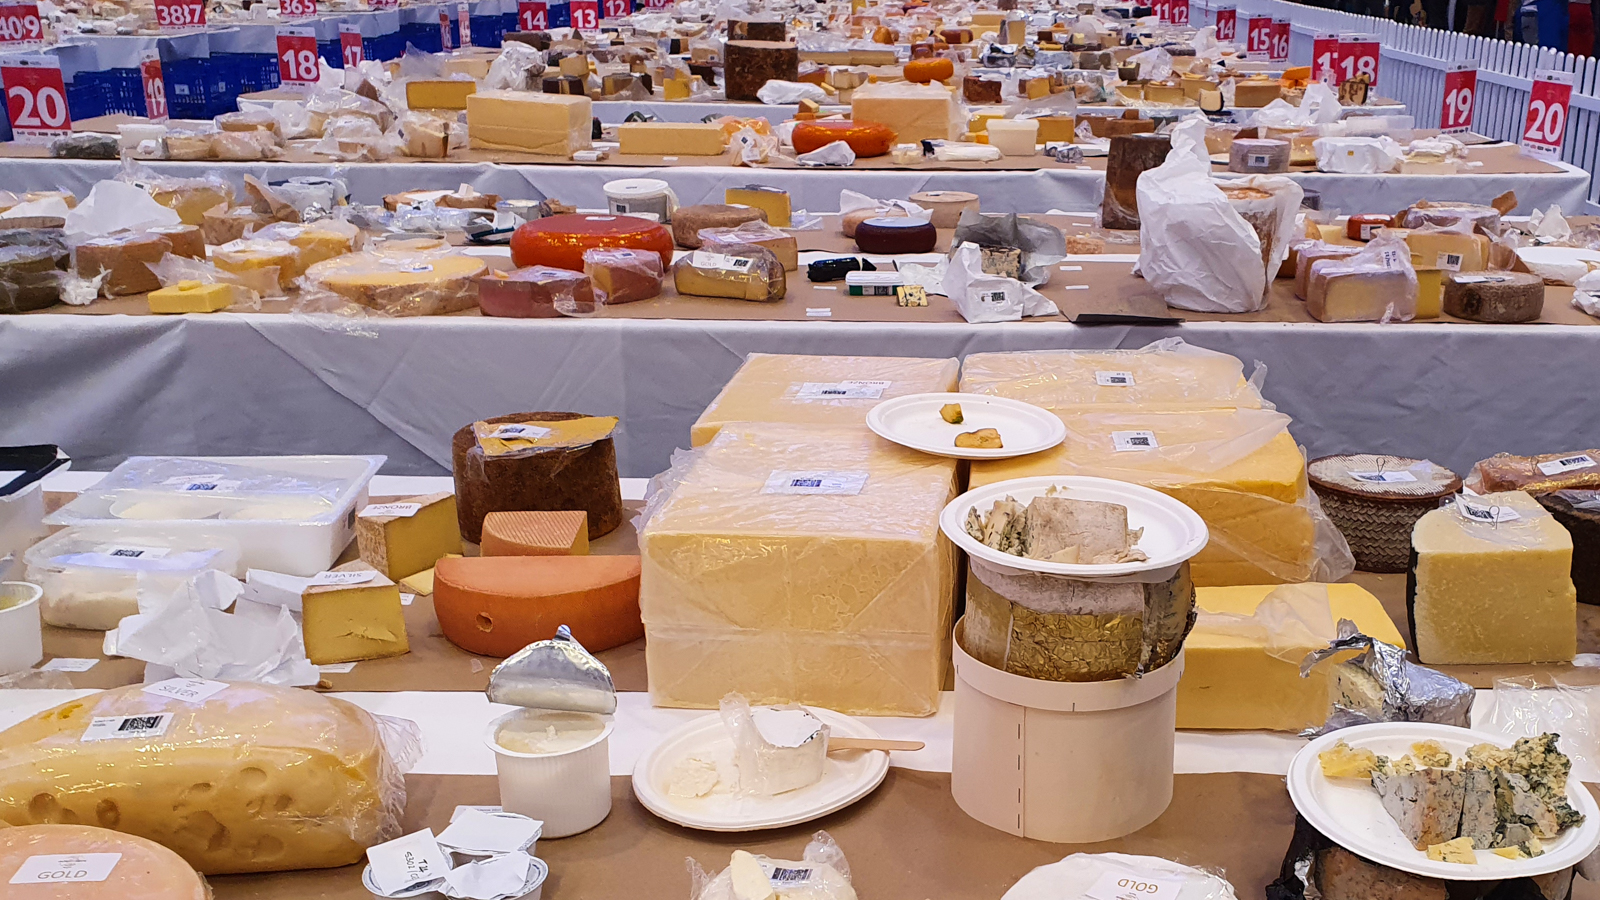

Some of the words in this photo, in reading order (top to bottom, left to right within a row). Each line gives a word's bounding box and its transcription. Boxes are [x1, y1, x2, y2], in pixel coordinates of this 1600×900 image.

[573, 9, 597, 29] 13
[605, 1, 627, 17] 12
[1173, 6, 1188, 23] 12
[522, 10, 547, 30] 14
[1218, 18, 1235, 39] 14
[1250, 28, 1270, 50] 15
[1272, 34, 1288, 58] 16
[281, 49, 318, 80] 18
[344, 45, 362, 68] 17
[1340, 55, 1376, 83] 18
[8, 85, 67, 128] 20
[1445, 87, 1473, 126] 19
[1524, 99, 1565, 143] 20
[159, 684, 199, 698] SILVER
[37, 870, 88, 880] GOLD
[1117, 878, 1159, 894] GOLD
